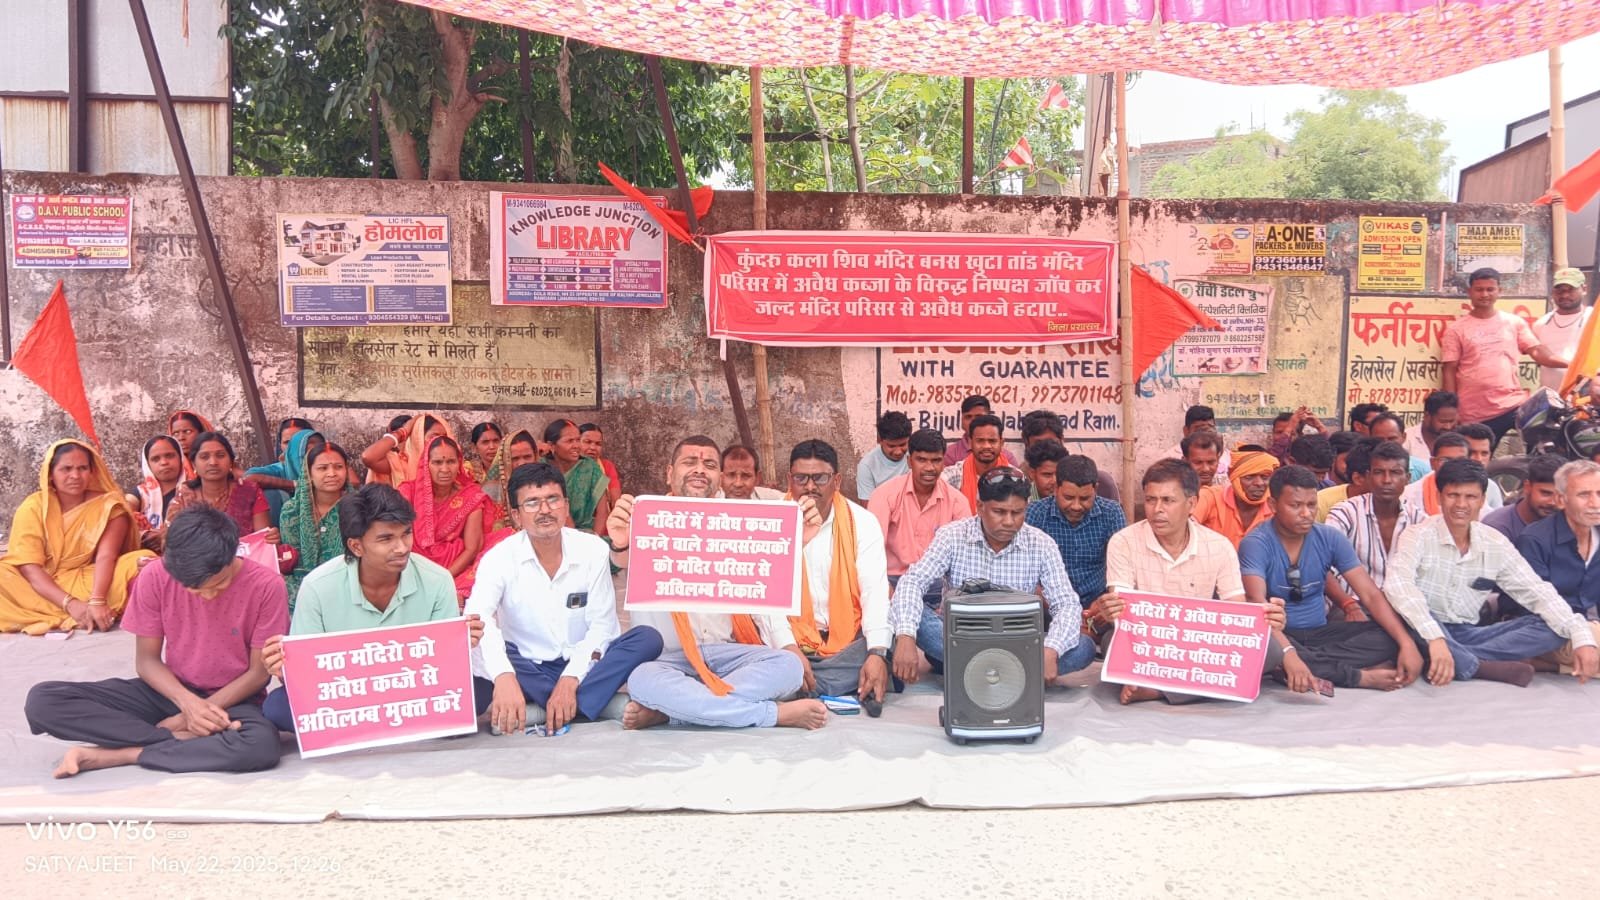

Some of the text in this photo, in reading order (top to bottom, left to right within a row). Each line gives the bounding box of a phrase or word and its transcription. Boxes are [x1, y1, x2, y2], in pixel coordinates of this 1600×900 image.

[38, 206, 125, 217] D.A.V. PUBLIC SCHOOL
[364, 221, 444, 241] होमलोन
[508, 205, 661, 240] KNOWLEDGE JUNCTION
[1375, 222, 1409, 230] VIKAS
[1467, 227, 1521, 236] MAA AMBEY
[536, 225, 635, 250] LIBRARY
[1255, 242, 1286, 250] PACKERS
[1295, 242, 1324, 250] MOVERS
[1363, 235, 1400, 243] ADMISSION
[300, 266, 328, 276] LIC HFL
[736, 248, 781, 273] कुंदरु
[786, 252, 828, 269] कला
[833, 249, 869, 269] शिव
[874, 249, 915, 269] मंदिर
[920, 255, 961, 270] बनस
[1007, 251, 1039, 270] तांड
[1043, 251, 1084, 271] मंदिर
[719, 271, 1103, 296] परिसर में अवैध कब्जा के विरुद्ध निष्पक्ष कर
[753, 300, 795, 316] जल्द
[799, 297, 840, 316] मंदिर
[845, 297, 896, 317] परिसर
[900, 297, 915, 317] से
[919, 296, 963, 317] अवैध
[967, 298, 1010, 317] कब्जे
[495, 322, 538, 339] कम्पनी
[542, 326, 560, 338] का
[1048, 322, 1068, 332] जिला
[1351, 301, 1456, 348] फर्नीचर
[427, 340, 440, 358] में
[444, 340, 478, 360] मिलते
[901, 360, 1110, 379] WITH GUARANTEE
[1350, 356, 1396, 382] होलसेल
[1083, 409, 1120, 432] Ram.
[646, 510, 688, 530] मंदिरों
[689, 512, 704, 530] में
[744, 517, 783, 533] कब्जा
[635, 533, 792, 555] करने वाले अल्पसंख्यकों
[652, 556, 772, 577] को मंदिर परिसर से
[655, 578, 767, 599] अविलम्ब निकाले
[1130, 600, 1168, 620] मंदिरों
[1169, 603, 1183, 621] में
[1220, 612, 1256, 628] कब्जा
[1119, 618, 1264, 649] करने वाले अल्पसंख्यकों
[314, 636, 435, 671] मठ मंदिरो को
[1132, 641, 1243, 668] को मंदिर परिसर से
[370, 667, 416, 693] कब्जे
[420, 663, 439, 686] से
[1190, 667, 1238, 688] निकाले
[298, 687, 463, 734] अविलम्ब मुक्त करें
